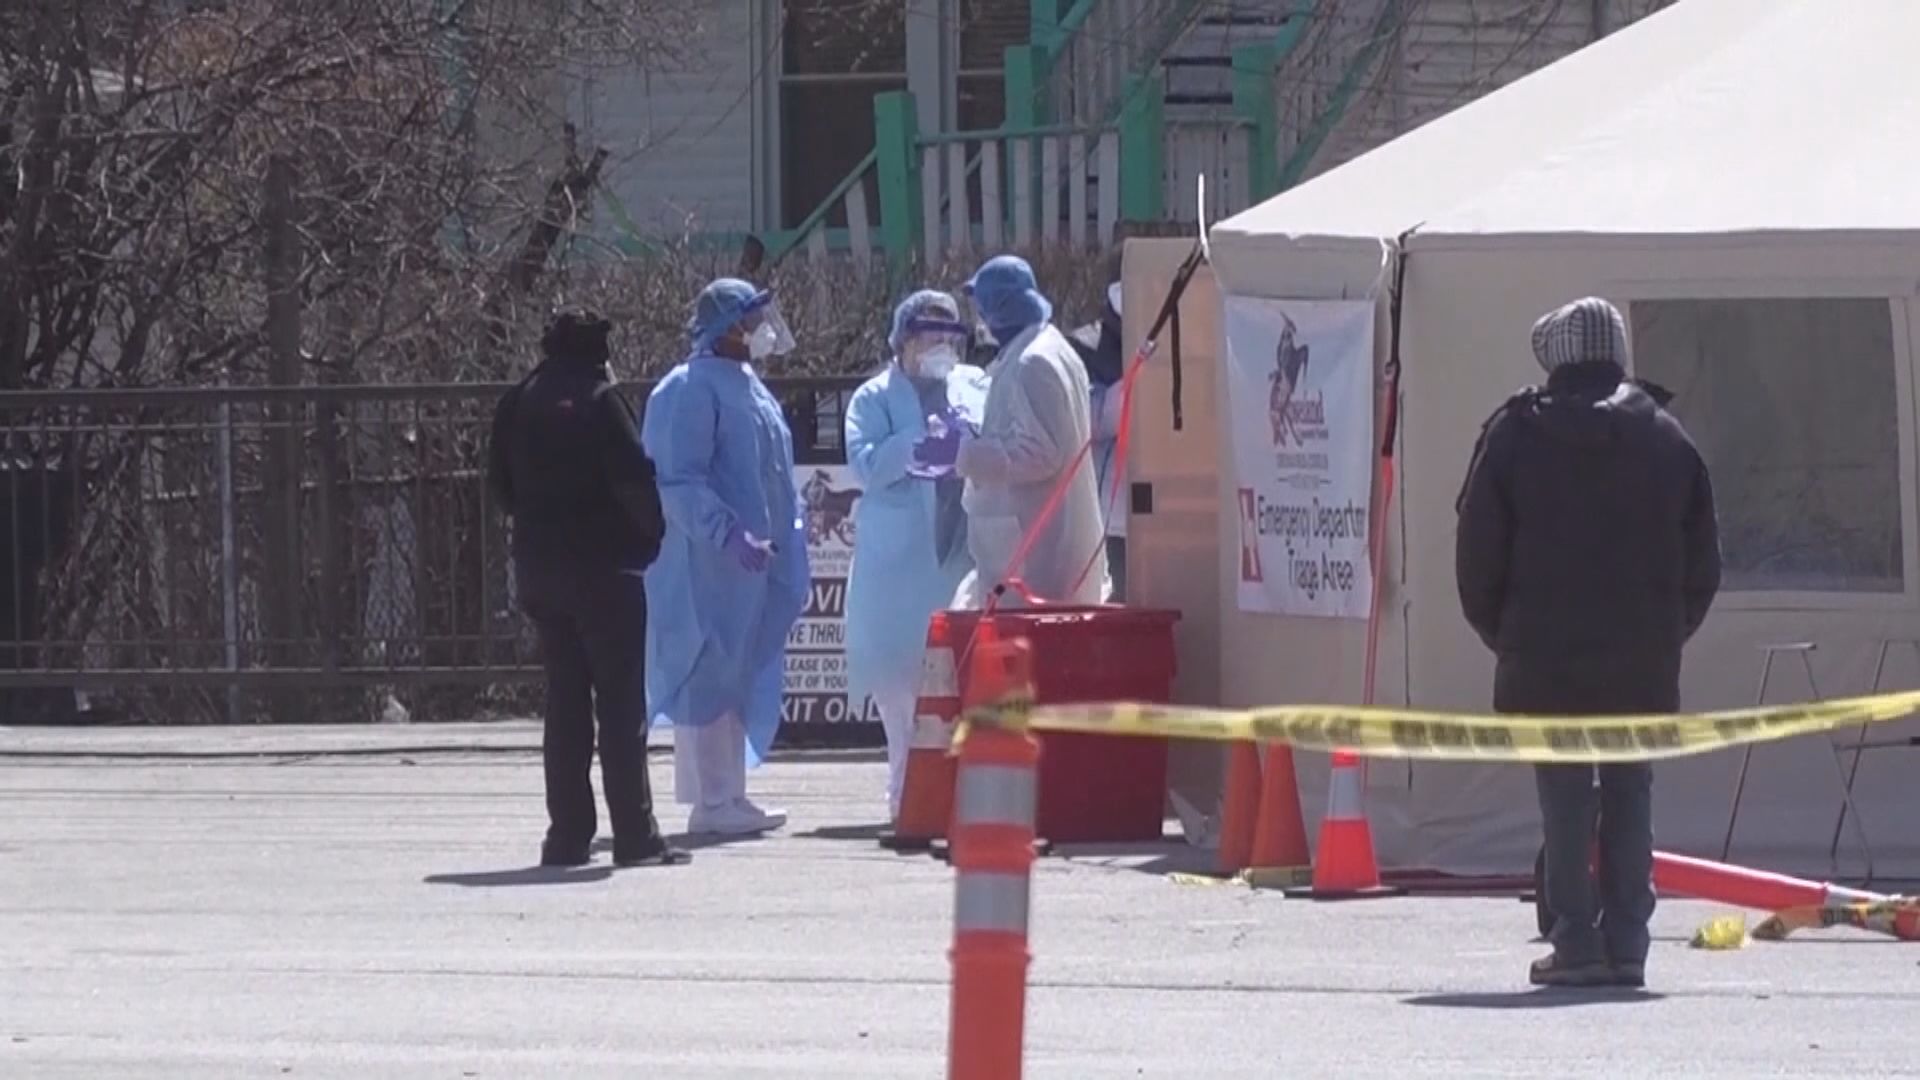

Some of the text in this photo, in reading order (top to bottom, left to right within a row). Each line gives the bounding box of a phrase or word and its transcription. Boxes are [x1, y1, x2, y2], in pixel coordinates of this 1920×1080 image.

[1257, 495, 1311, 548] Emergency
[1288, 548, 1354, 601] Triage Area
[809, 623, 845, 644] THRU
[822, 657, 839, 671] DO
[805, 675, 820, 688] OF
[824, 675, 848, 688] YOU
